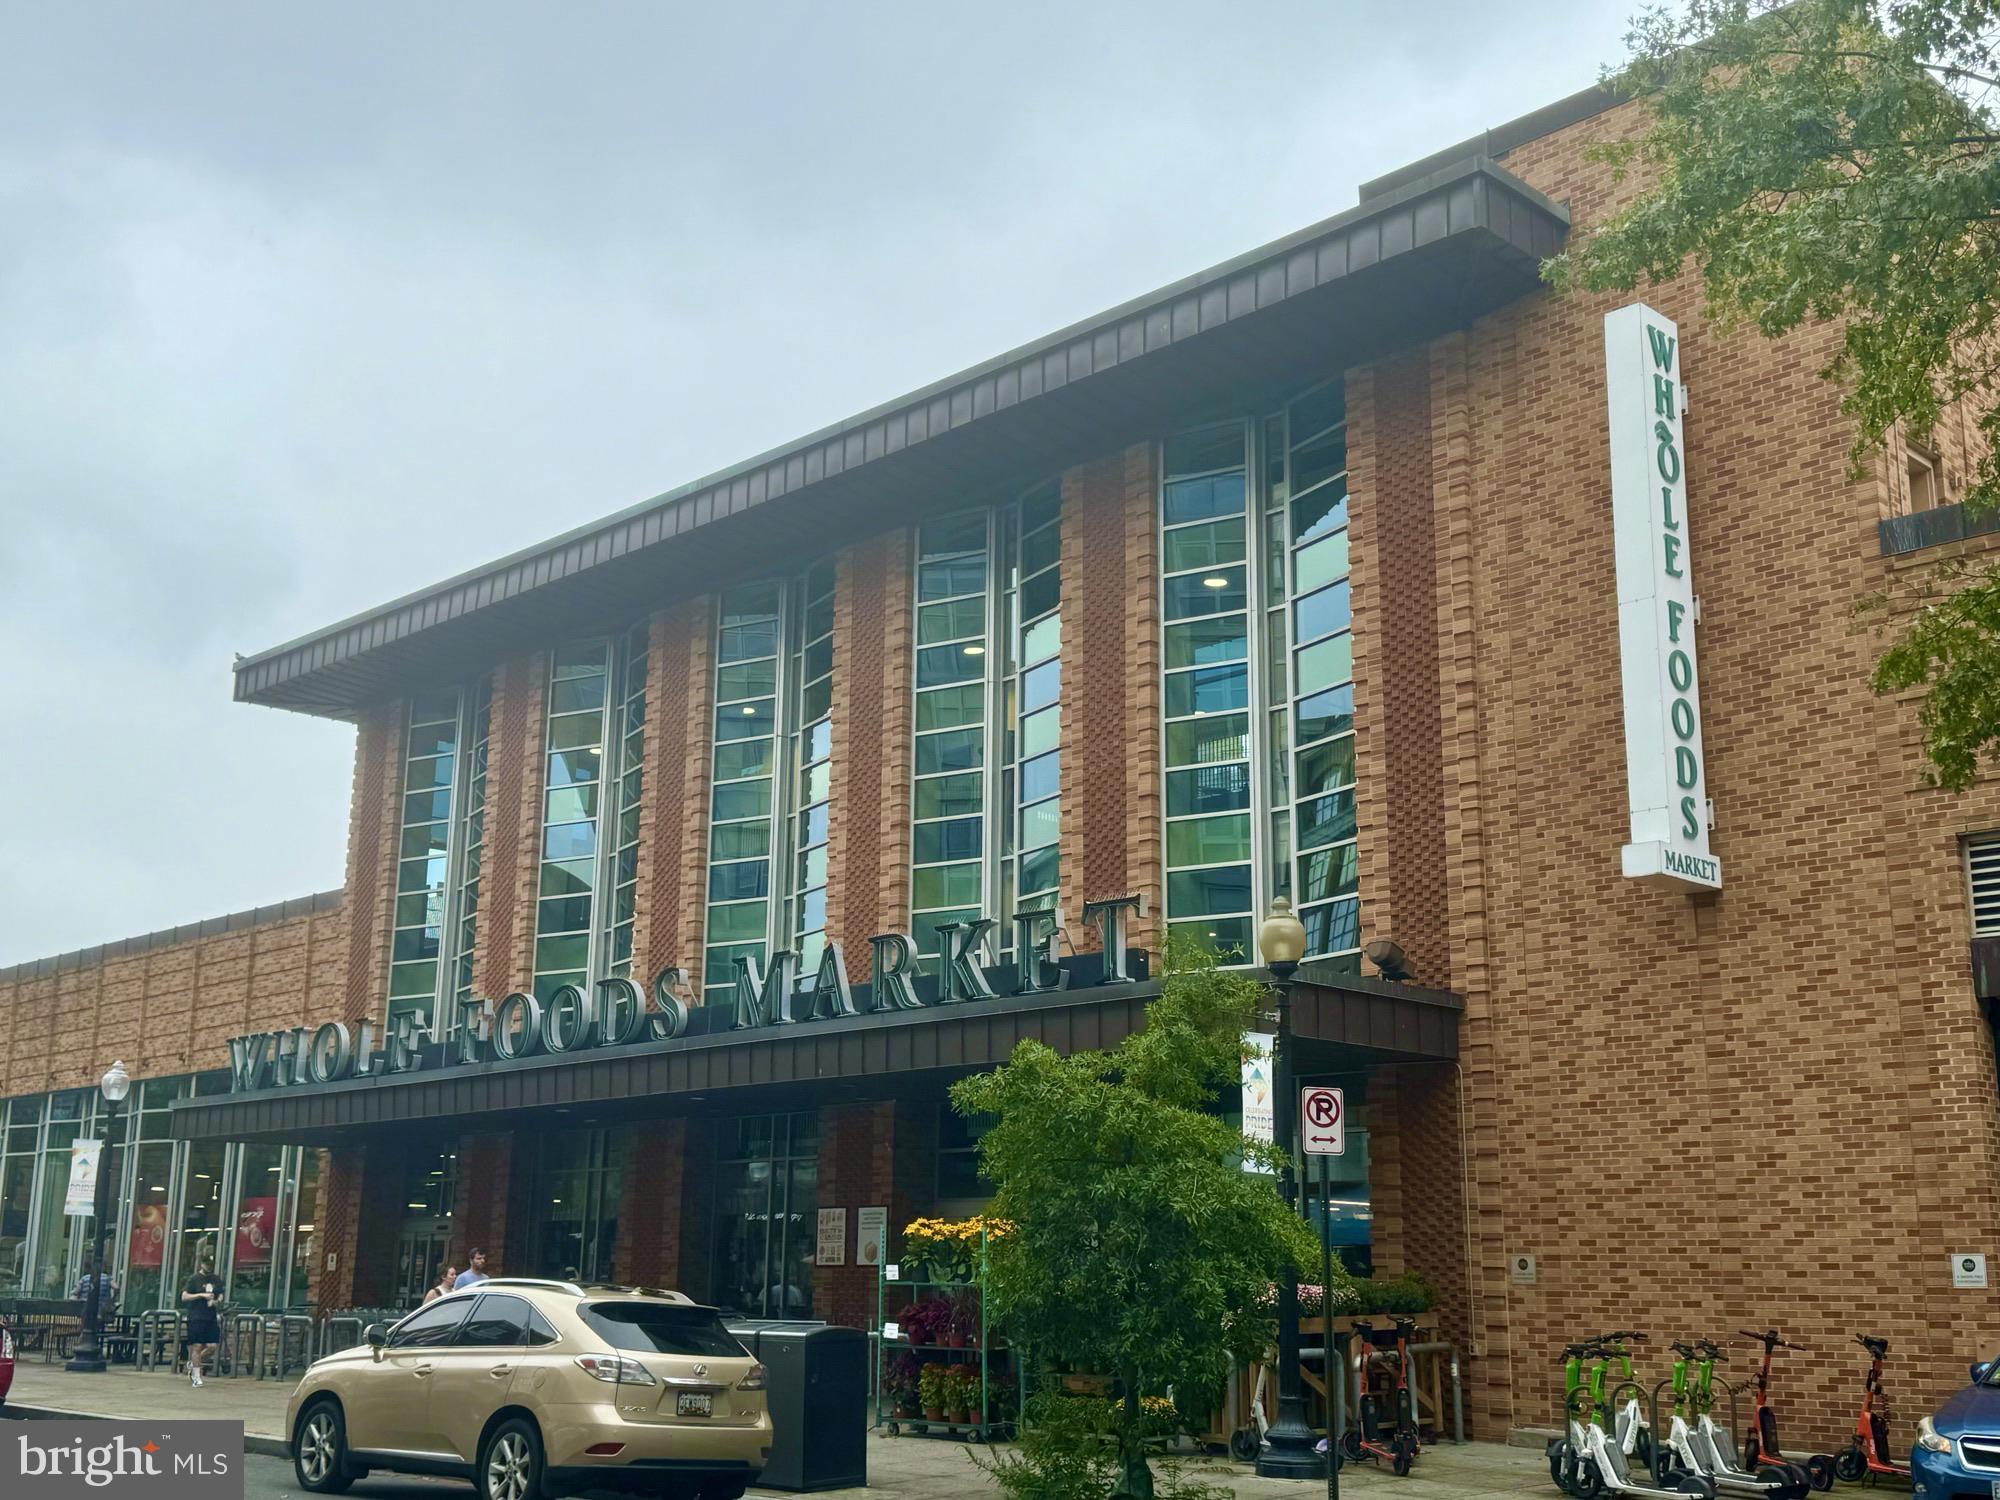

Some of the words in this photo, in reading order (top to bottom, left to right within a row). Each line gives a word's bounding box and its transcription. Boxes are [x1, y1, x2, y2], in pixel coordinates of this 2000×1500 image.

[1647, 324, 1683, 579] WHOLE
[1667, 599, 1698, 840] FOODS
[1665, 849, 1716, 882] MARKET
[226, 1008, 427, 1095] WHOLE
[459, 967, 689, 1065] FOODS
[732, 893, 1149, 1031] MARKET
[1245, 1115, 1273, 1130] PRIDE
